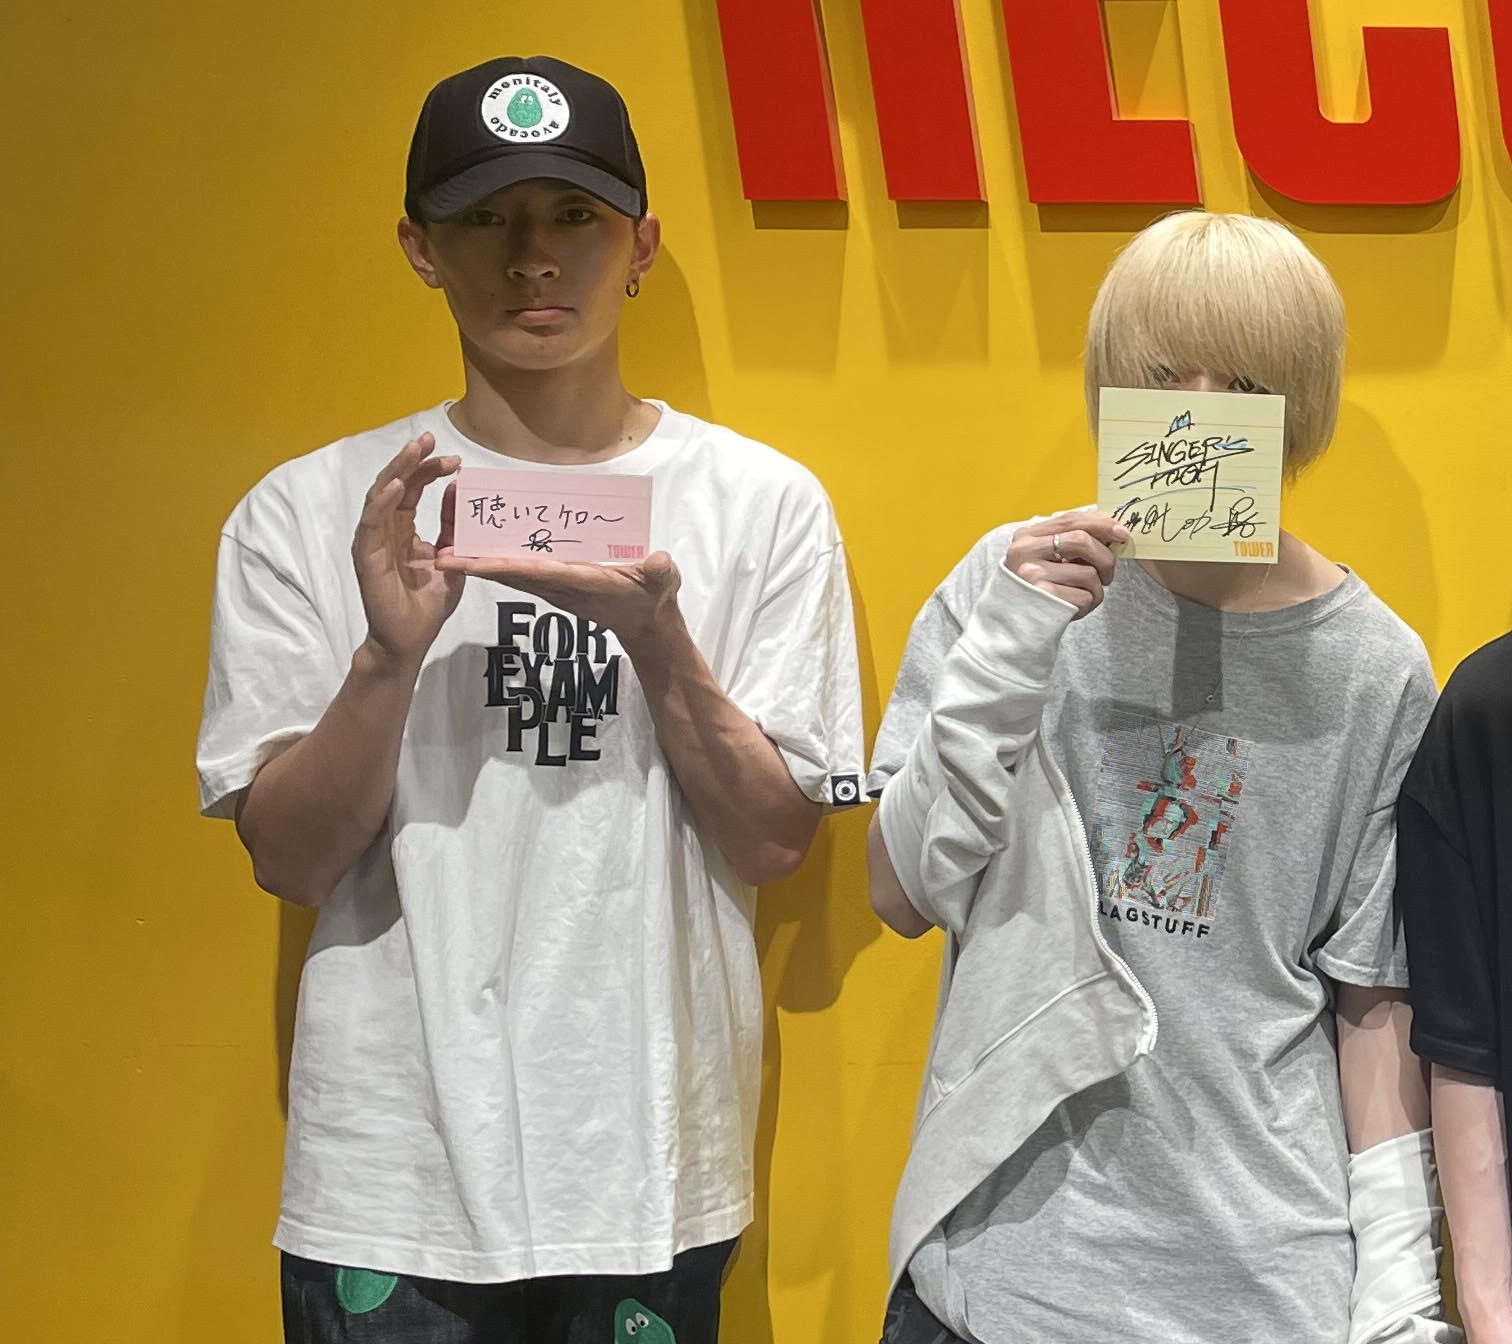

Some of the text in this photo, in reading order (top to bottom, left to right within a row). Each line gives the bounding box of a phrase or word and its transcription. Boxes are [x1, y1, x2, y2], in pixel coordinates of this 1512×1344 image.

[487, 76, 563, 107] monitaly
[489, 115, 560, 139] avocado
[607, 543, 645, 559] TOWER
[1233, 540, 1275, 558] TOWER
[496, 601, 608, 663] FOR
[483, 646, 623, 722] EXAM
[506, 686, 602, 766] PLE
[1099, 899, 1211, 939] LAGSTUFF
